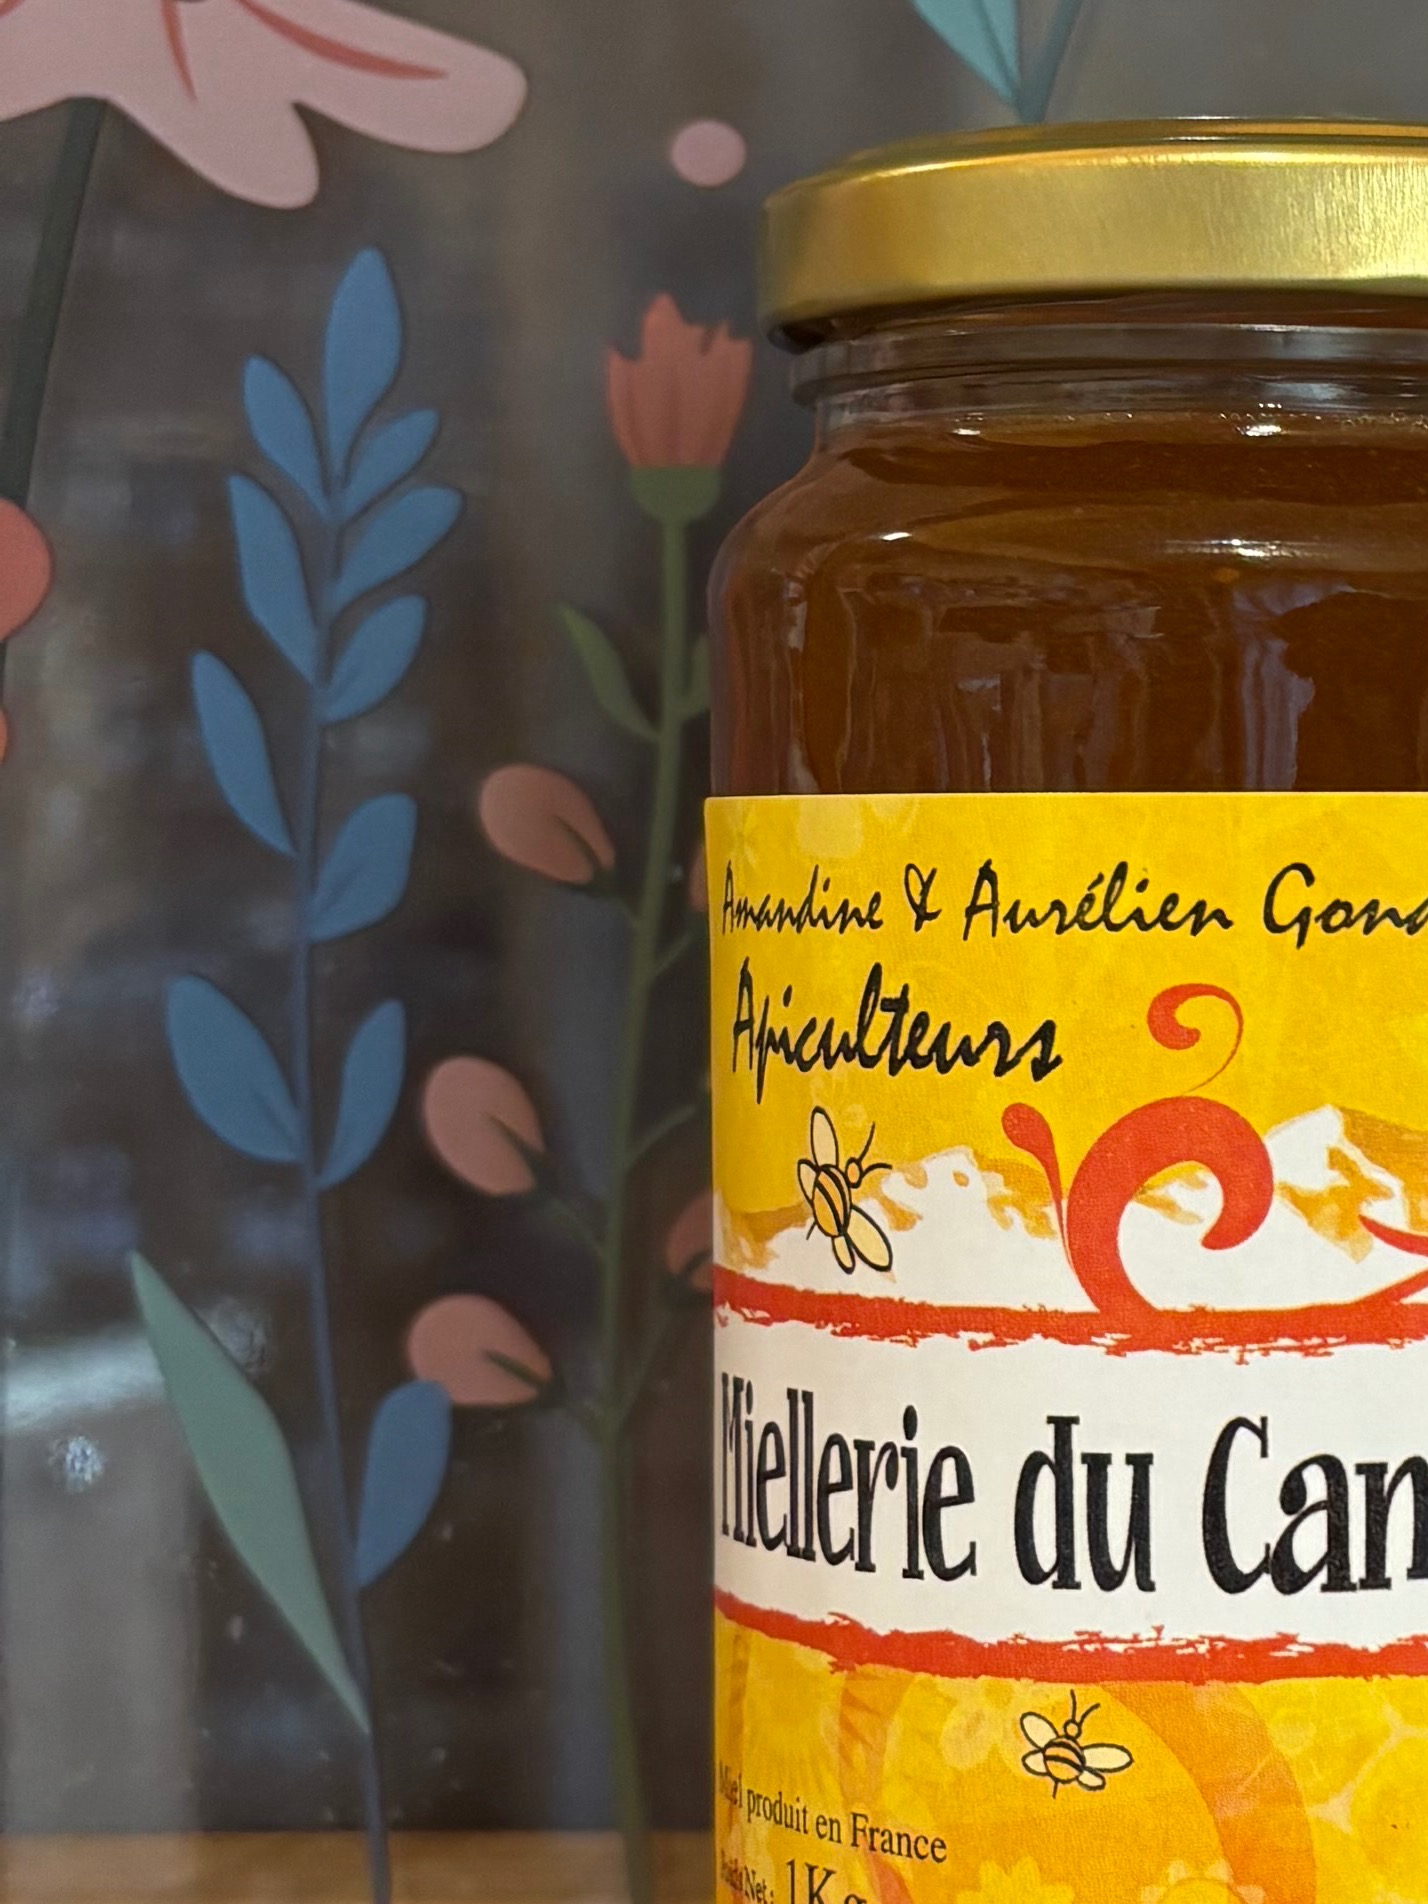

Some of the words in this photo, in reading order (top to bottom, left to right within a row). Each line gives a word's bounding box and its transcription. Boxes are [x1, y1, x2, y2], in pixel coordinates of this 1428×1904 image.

[722, 859, 884, 937] Amandine
[904, 863, 943, 930] &
[963, 859, 1234, 940] Aurélien
[733, 957, 1063, 1105] Apiculteurs
[721, 1372, 977, 1582] Miellerie
[1014, 1415, 1156, 1593] du
[747, 1789, 808, 1835] produit
[816, 1813, 842, 1845] en
[850, 1811, 948, 1864] France
